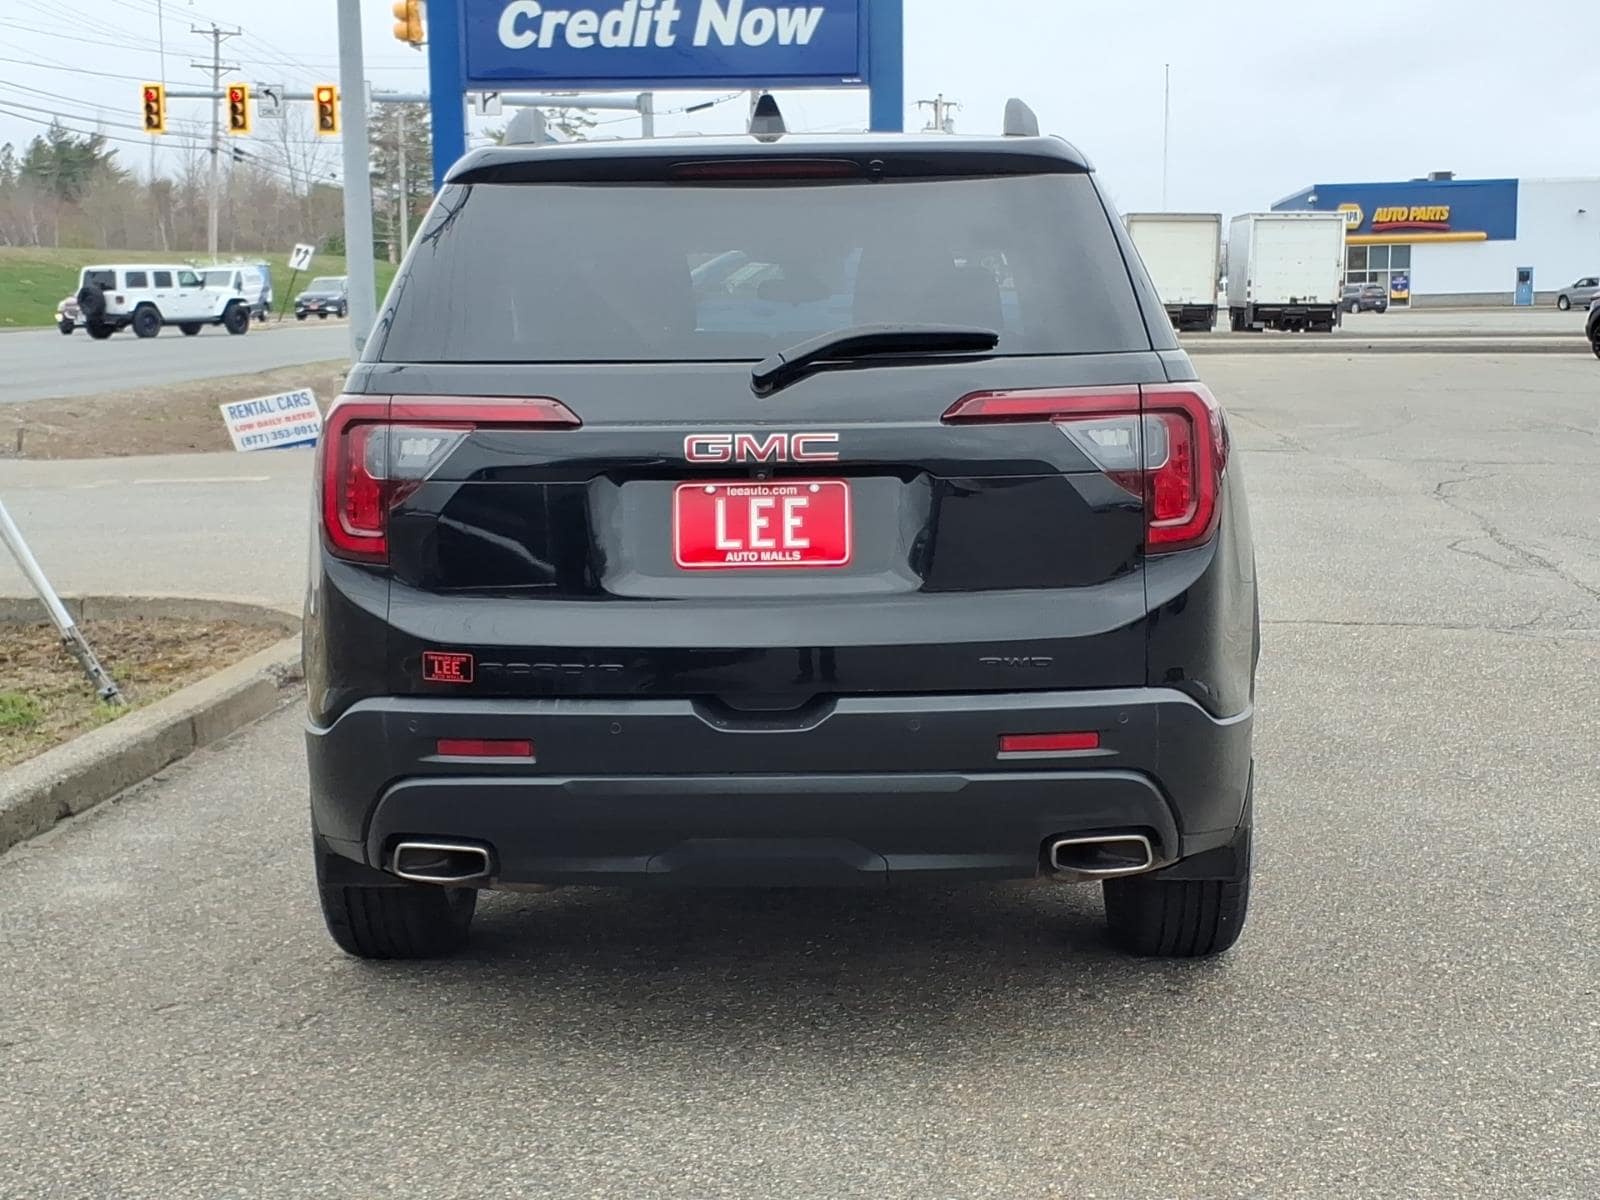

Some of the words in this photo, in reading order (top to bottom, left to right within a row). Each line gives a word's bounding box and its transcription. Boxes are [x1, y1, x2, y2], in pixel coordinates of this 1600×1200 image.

[497, 0, 681, 49] Credit
[692, 1, 825, 47] Now
[1345, 211, 1359, 223] APA
[1372, 207, 1408, 222] AUTO
[1409, 206, 1450, 221] PARTS
[228, 401, 275, 420] RENTAL
[277, 392, 311, 410] CARS
[235, 422, 254, 433] LOW
[257, 417, 282, 428] DAILY
[272, 423, 320, 441] 353-0011
[684, 432, 840, 463] GMC
[727, 485, 797, 497] leeauto.com
[714, 496, 811, 551] LEE
[725, 551, 758, 562] AUTO
[760, 550, 802, 562] MALLS
[434, 660, 461, 675] LEE
